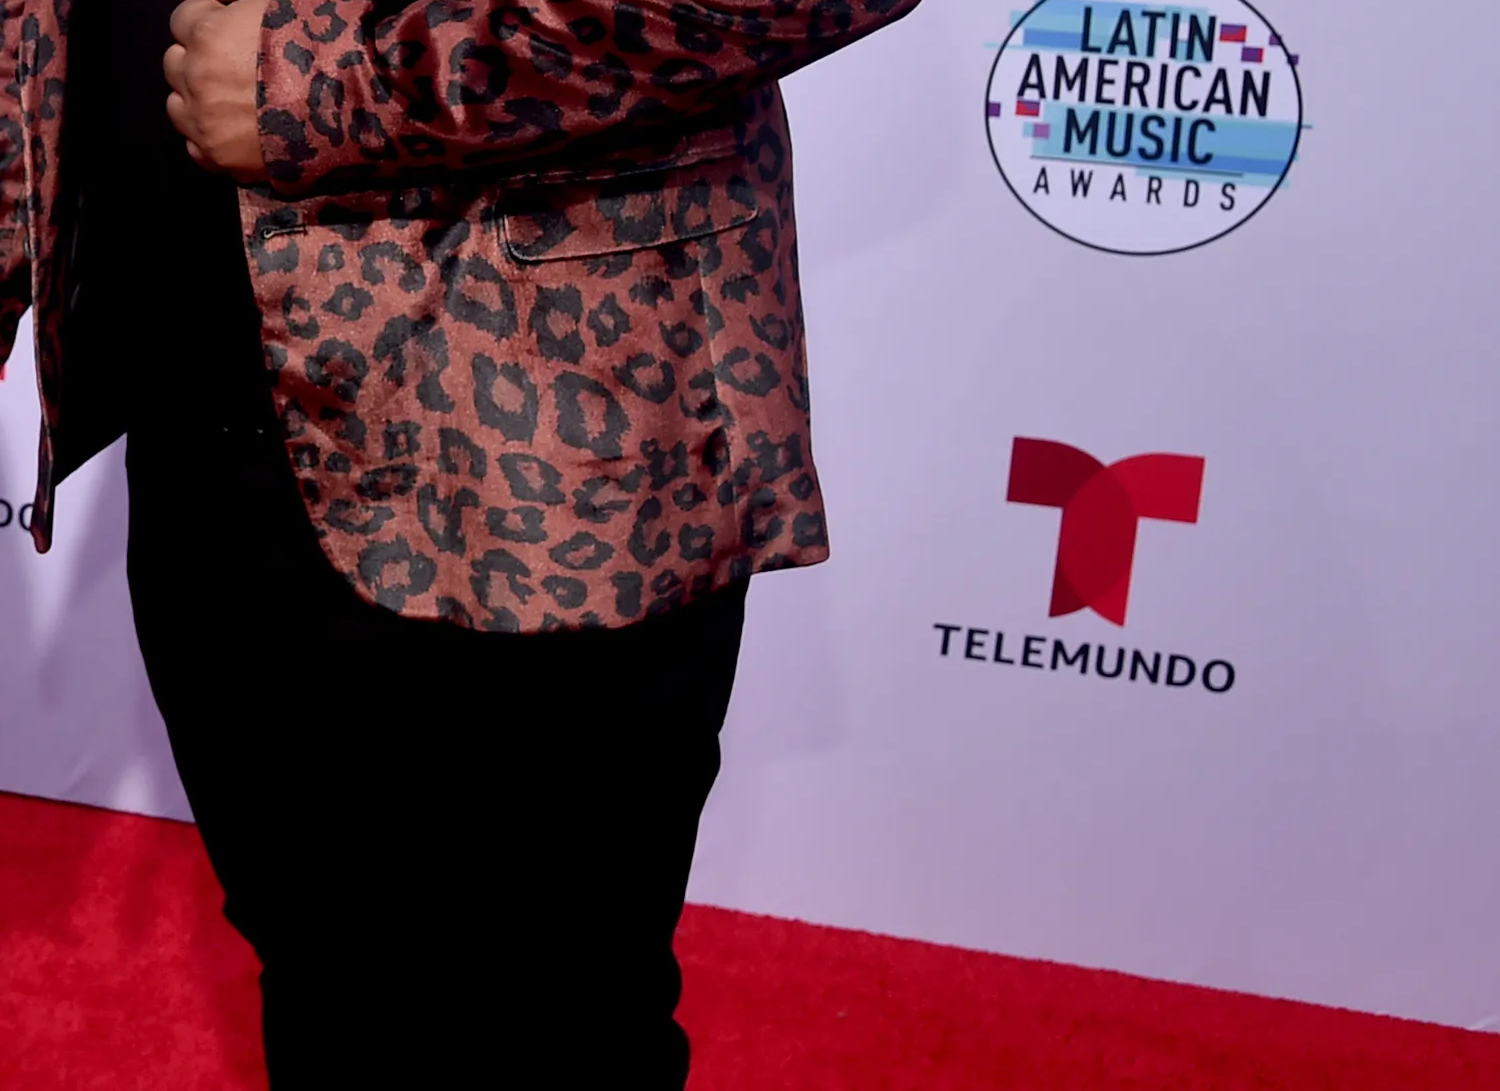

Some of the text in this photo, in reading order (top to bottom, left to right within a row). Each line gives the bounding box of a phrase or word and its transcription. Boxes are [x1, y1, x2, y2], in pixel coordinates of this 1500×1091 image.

[1080, 6, 1217, 63] LATIN
[1016, 53, 1271, 118] AMERICAN
[1063, 107, 1216, 166] MUSIC
[1033, 167, 1236, 211] AWARDS
[933, 623, 1236, 693] TELEMUNDO
